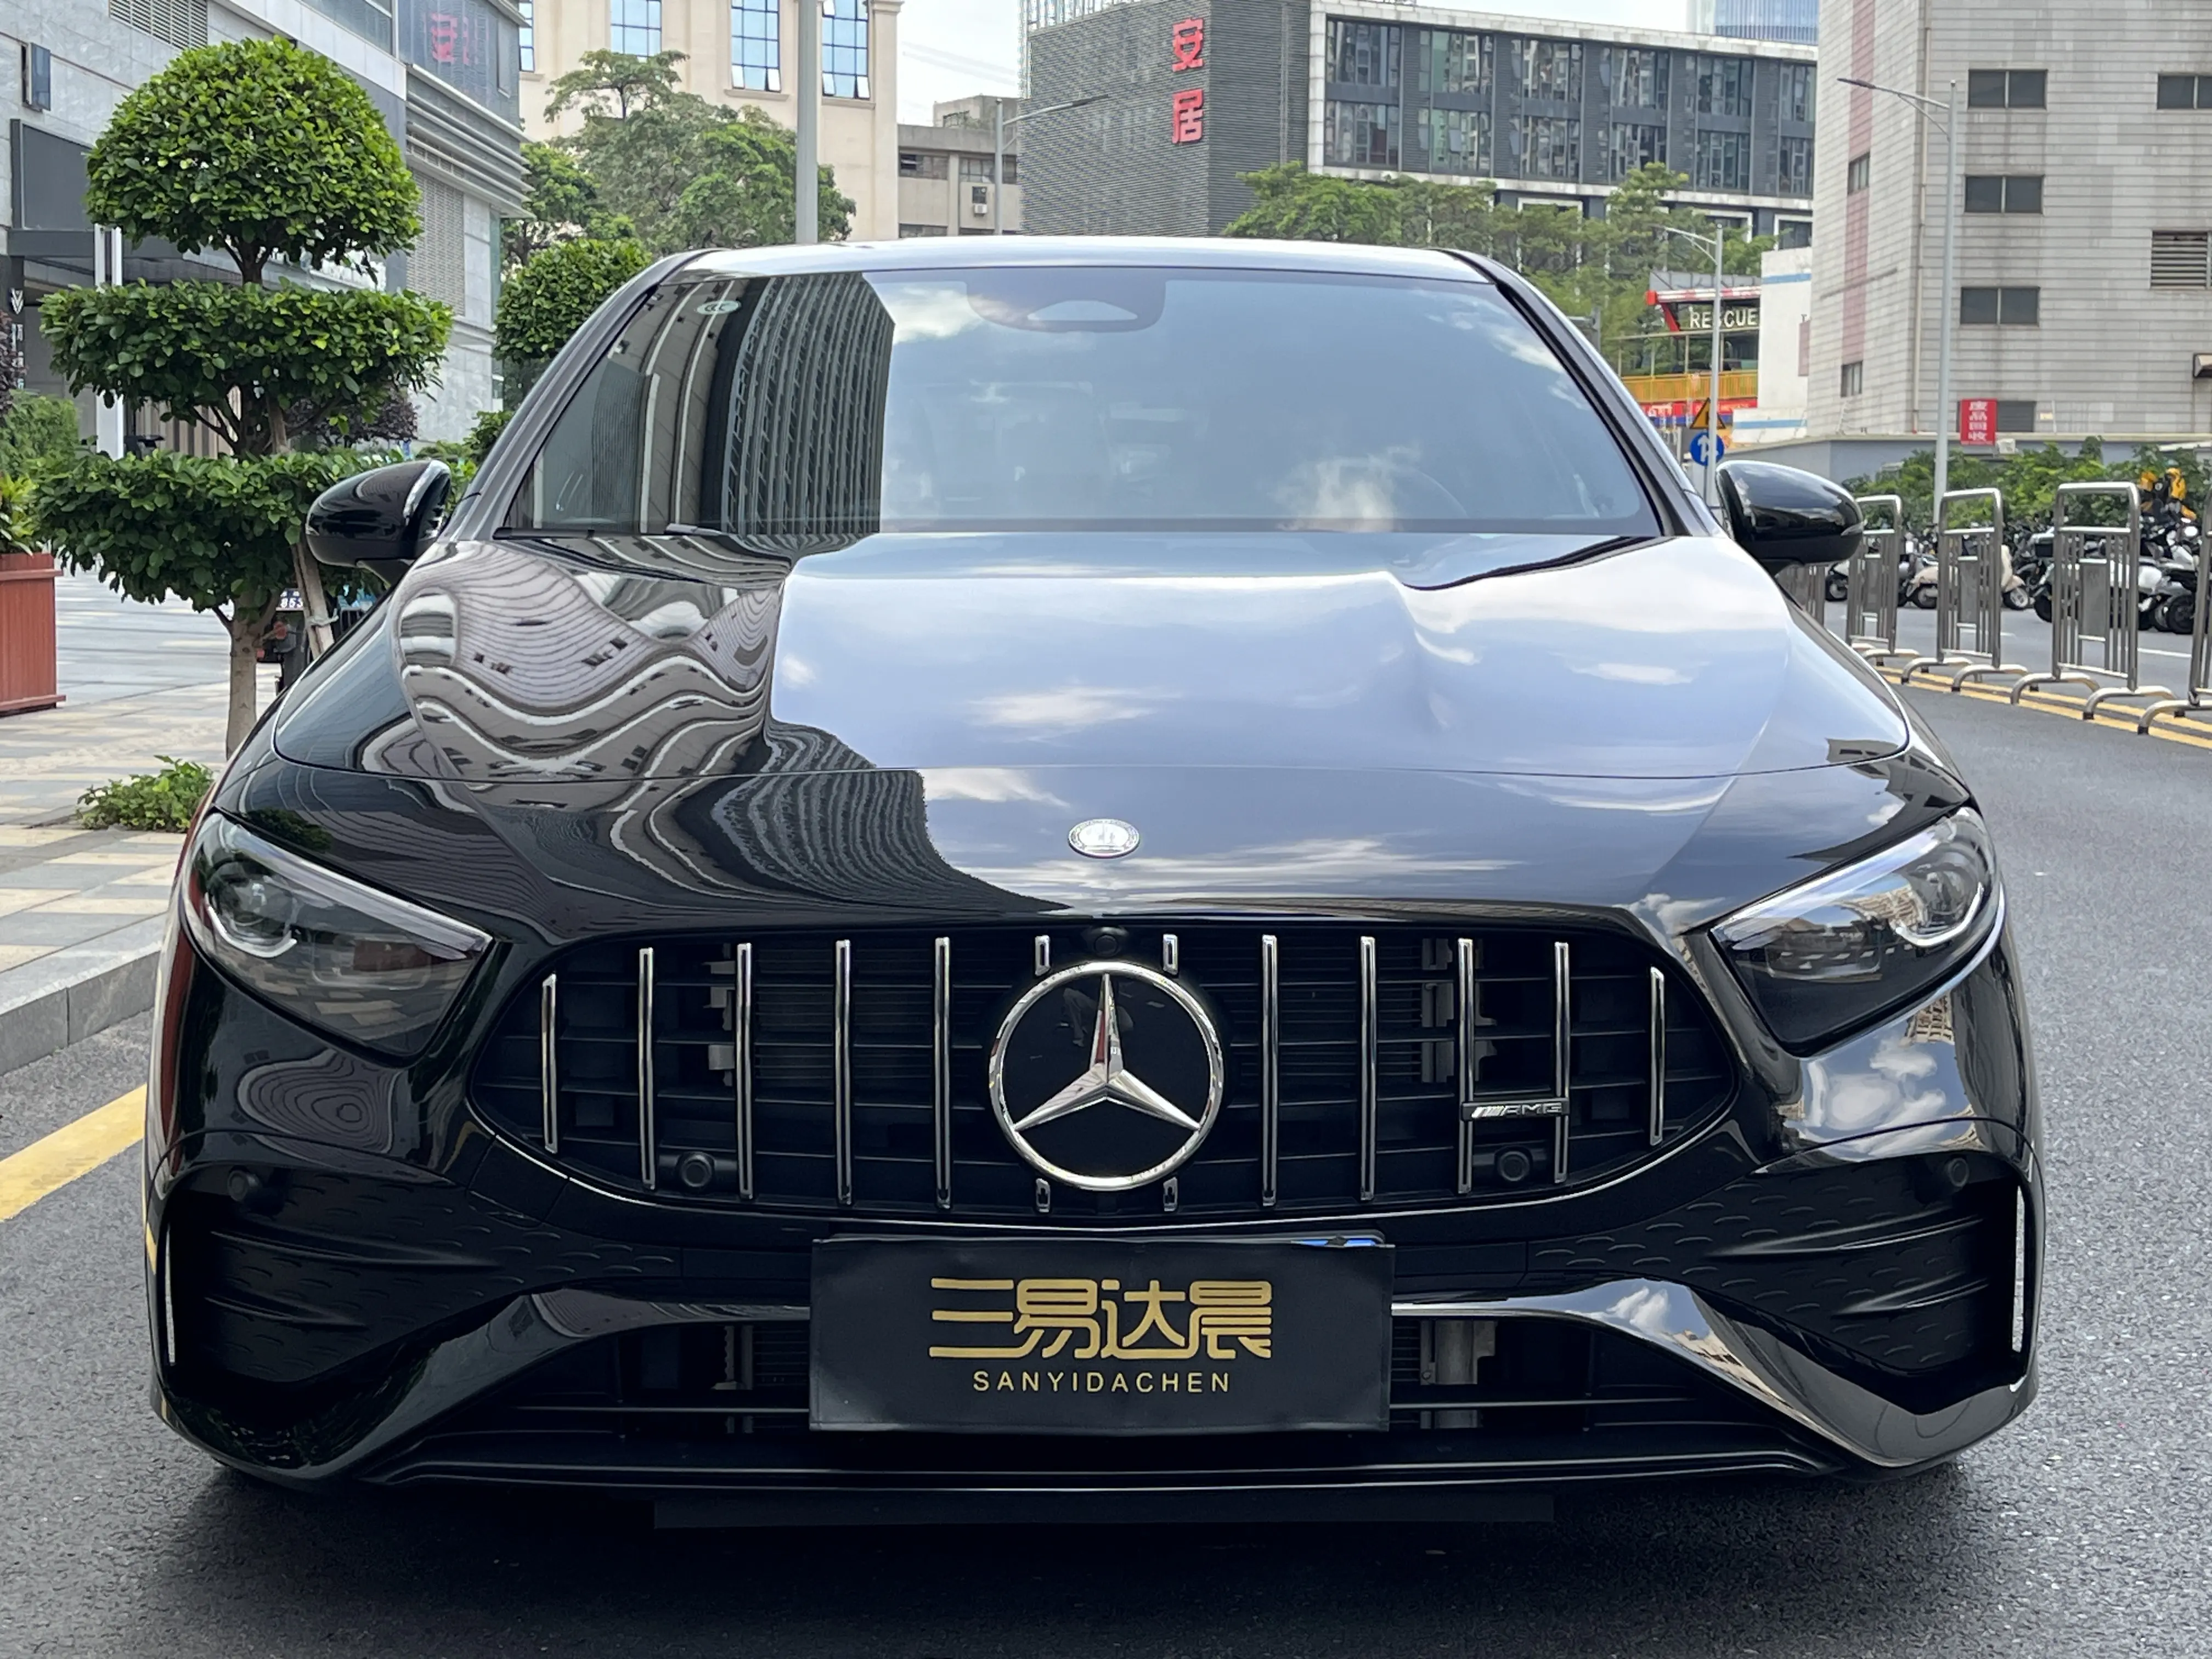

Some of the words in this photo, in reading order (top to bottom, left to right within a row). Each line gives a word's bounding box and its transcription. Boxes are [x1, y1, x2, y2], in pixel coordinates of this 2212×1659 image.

[1172, 18, 1204, 144] 安居
[1690, 308, 1757, 328] RECUE
[1501, 1102, 1562, 1116] AMG
[929, 1278, 1272, 1359] 三易达晨
[973, 1372, 1230, 1392] SANYIDACHEN
